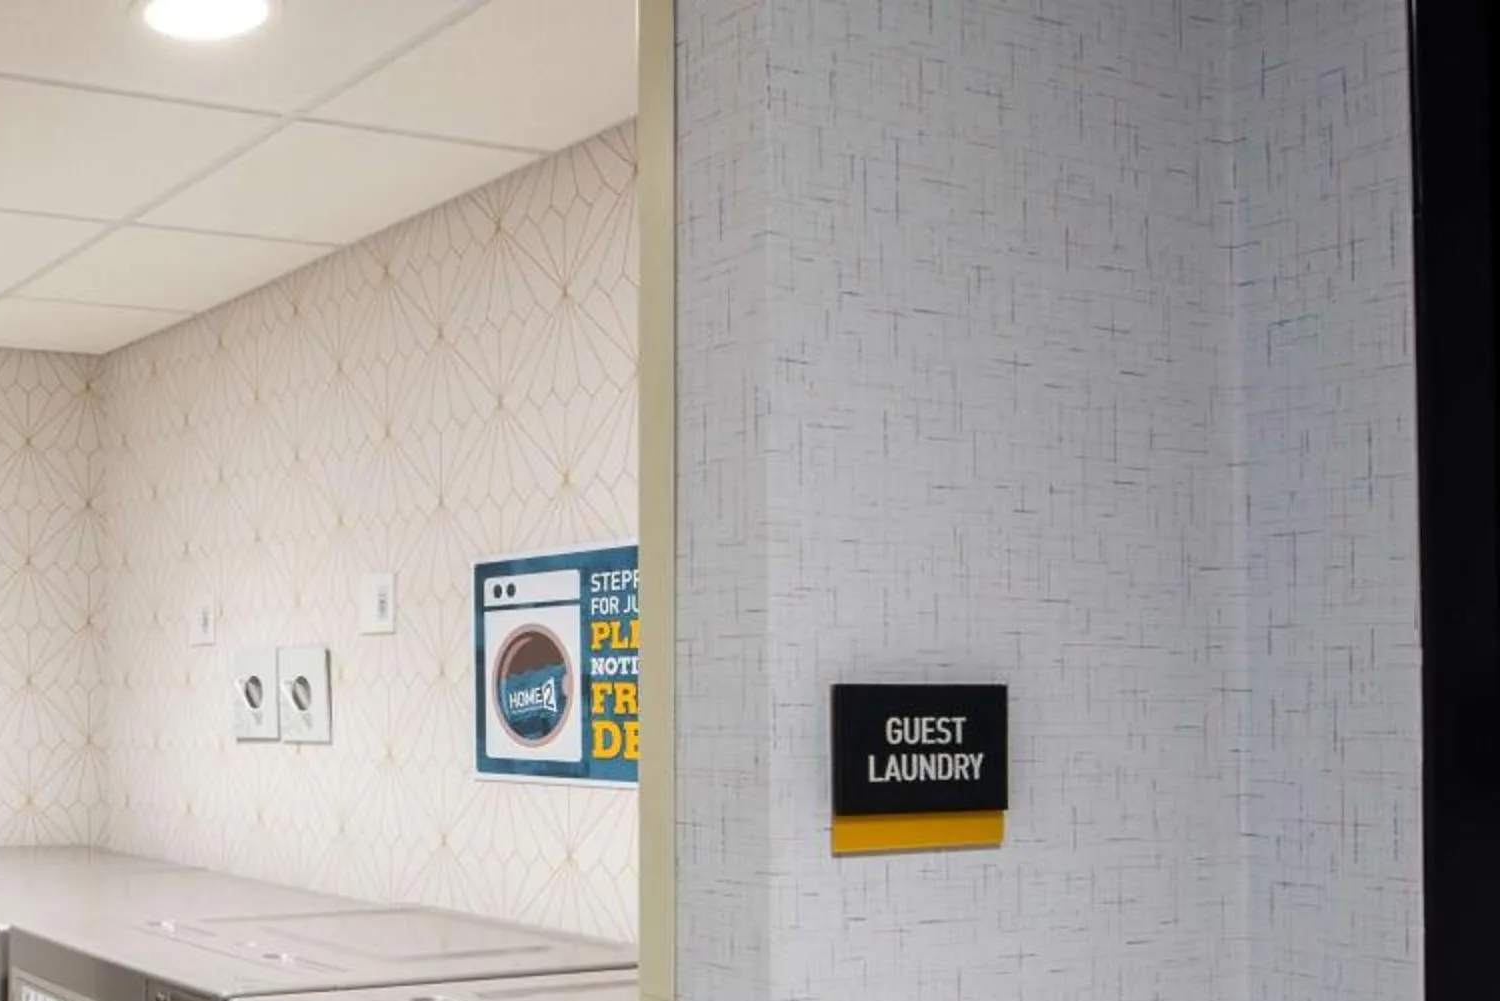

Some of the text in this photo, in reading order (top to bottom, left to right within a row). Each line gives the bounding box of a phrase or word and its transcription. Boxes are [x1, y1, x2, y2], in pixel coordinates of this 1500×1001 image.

[591, 595, 620, 616] FOR
[885, 716, 967, 745] GUEST
[868, 753, 984, 782] LAUNDRY
